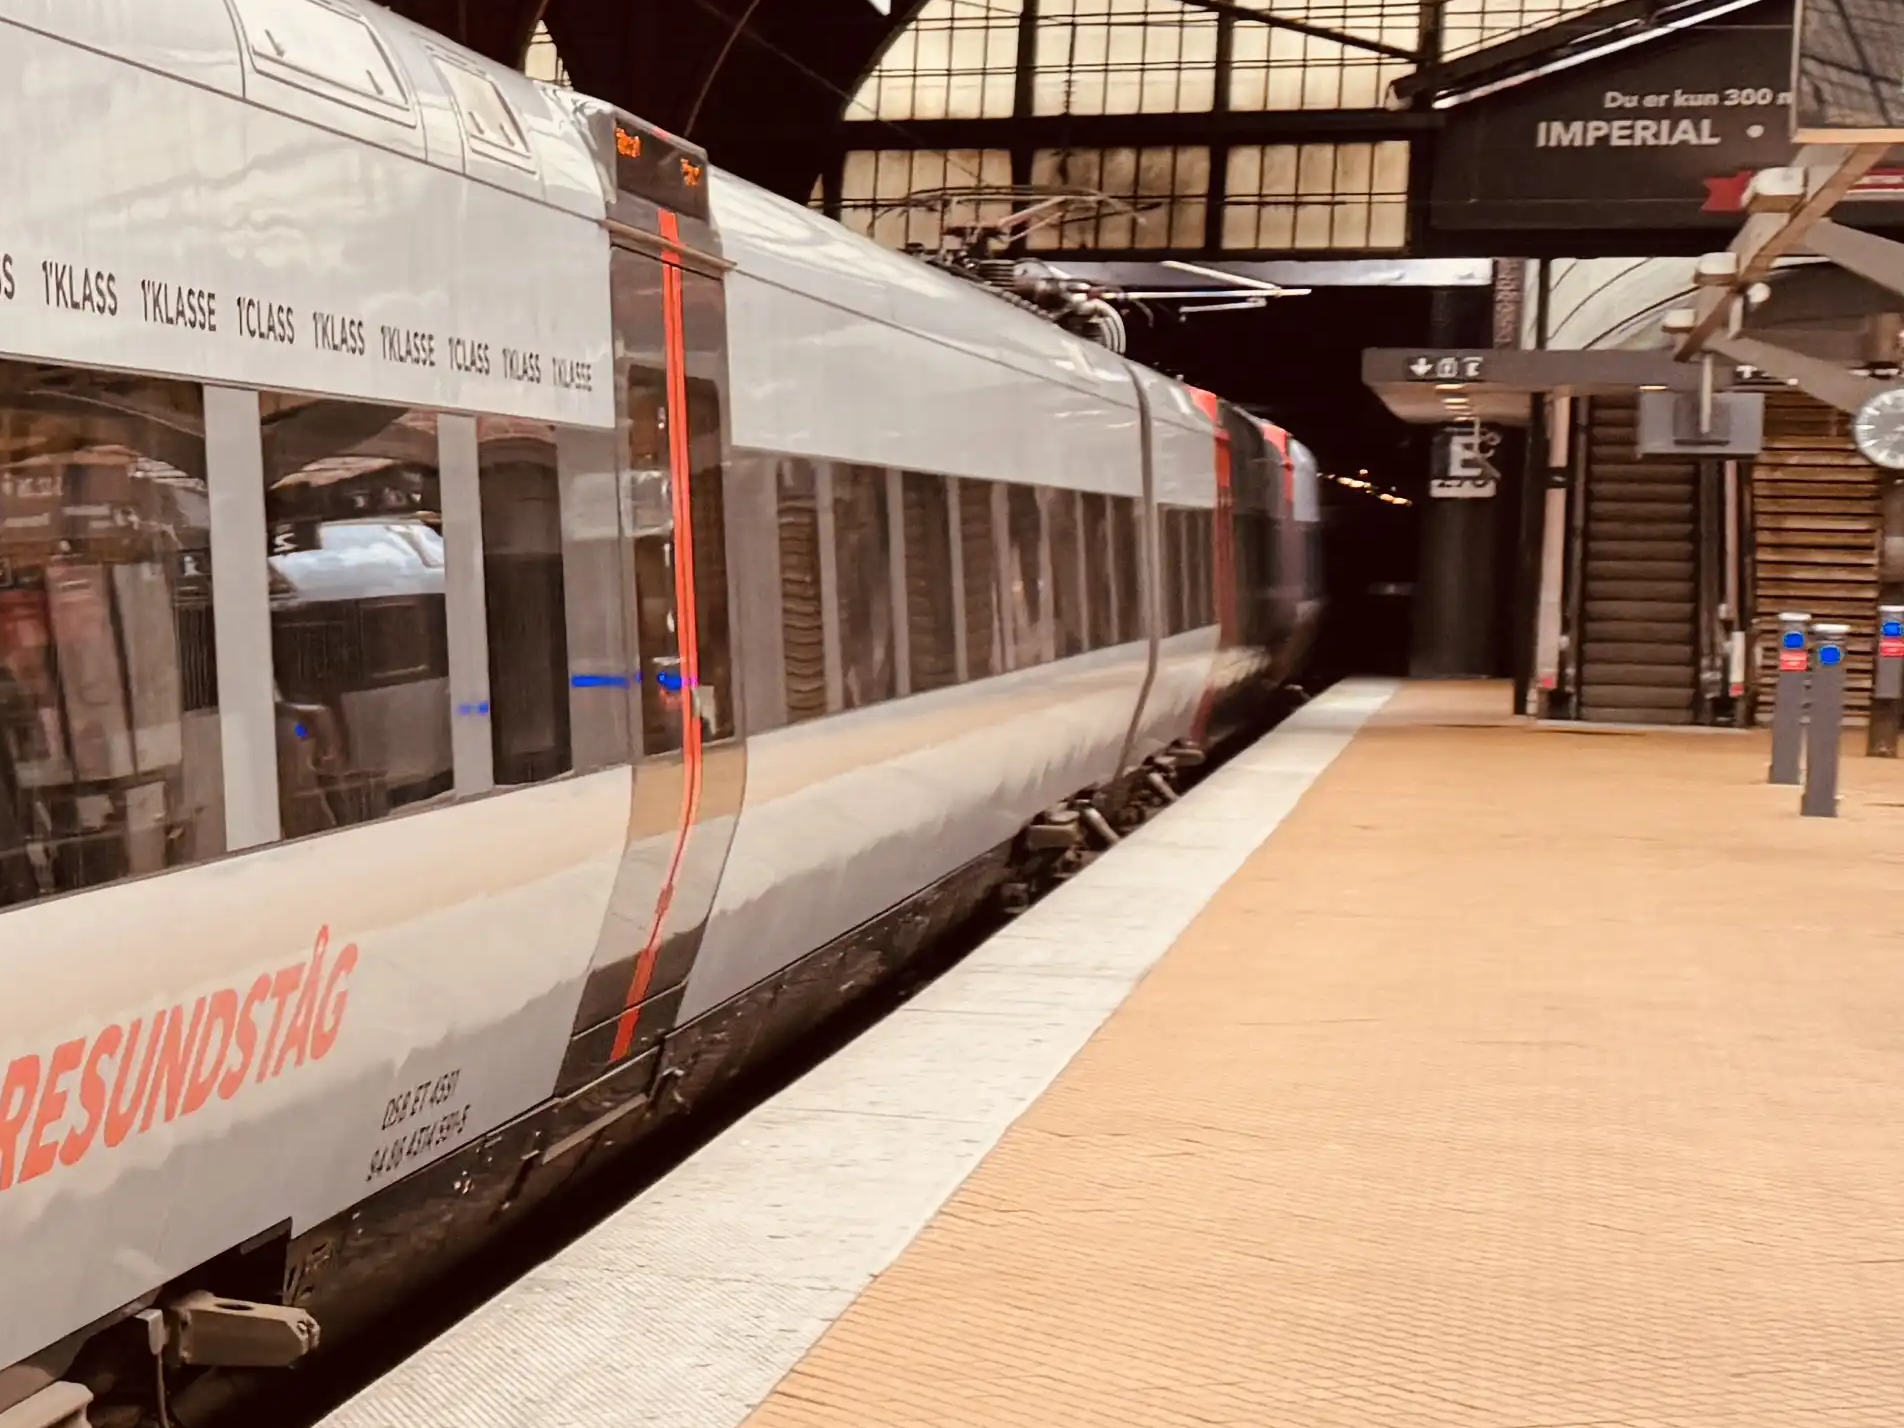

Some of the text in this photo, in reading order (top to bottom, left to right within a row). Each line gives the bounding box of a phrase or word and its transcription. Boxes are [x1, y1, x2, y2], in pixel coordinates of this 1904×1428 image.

[1603, 90, 1639, 109] Du
[1641, 93, 1671, 108] er
[1673, 88, 1719, 108] kun
[1723, 87, 1773, 107] 300
[1535, 118, 1722, 147] IMPERIAL
